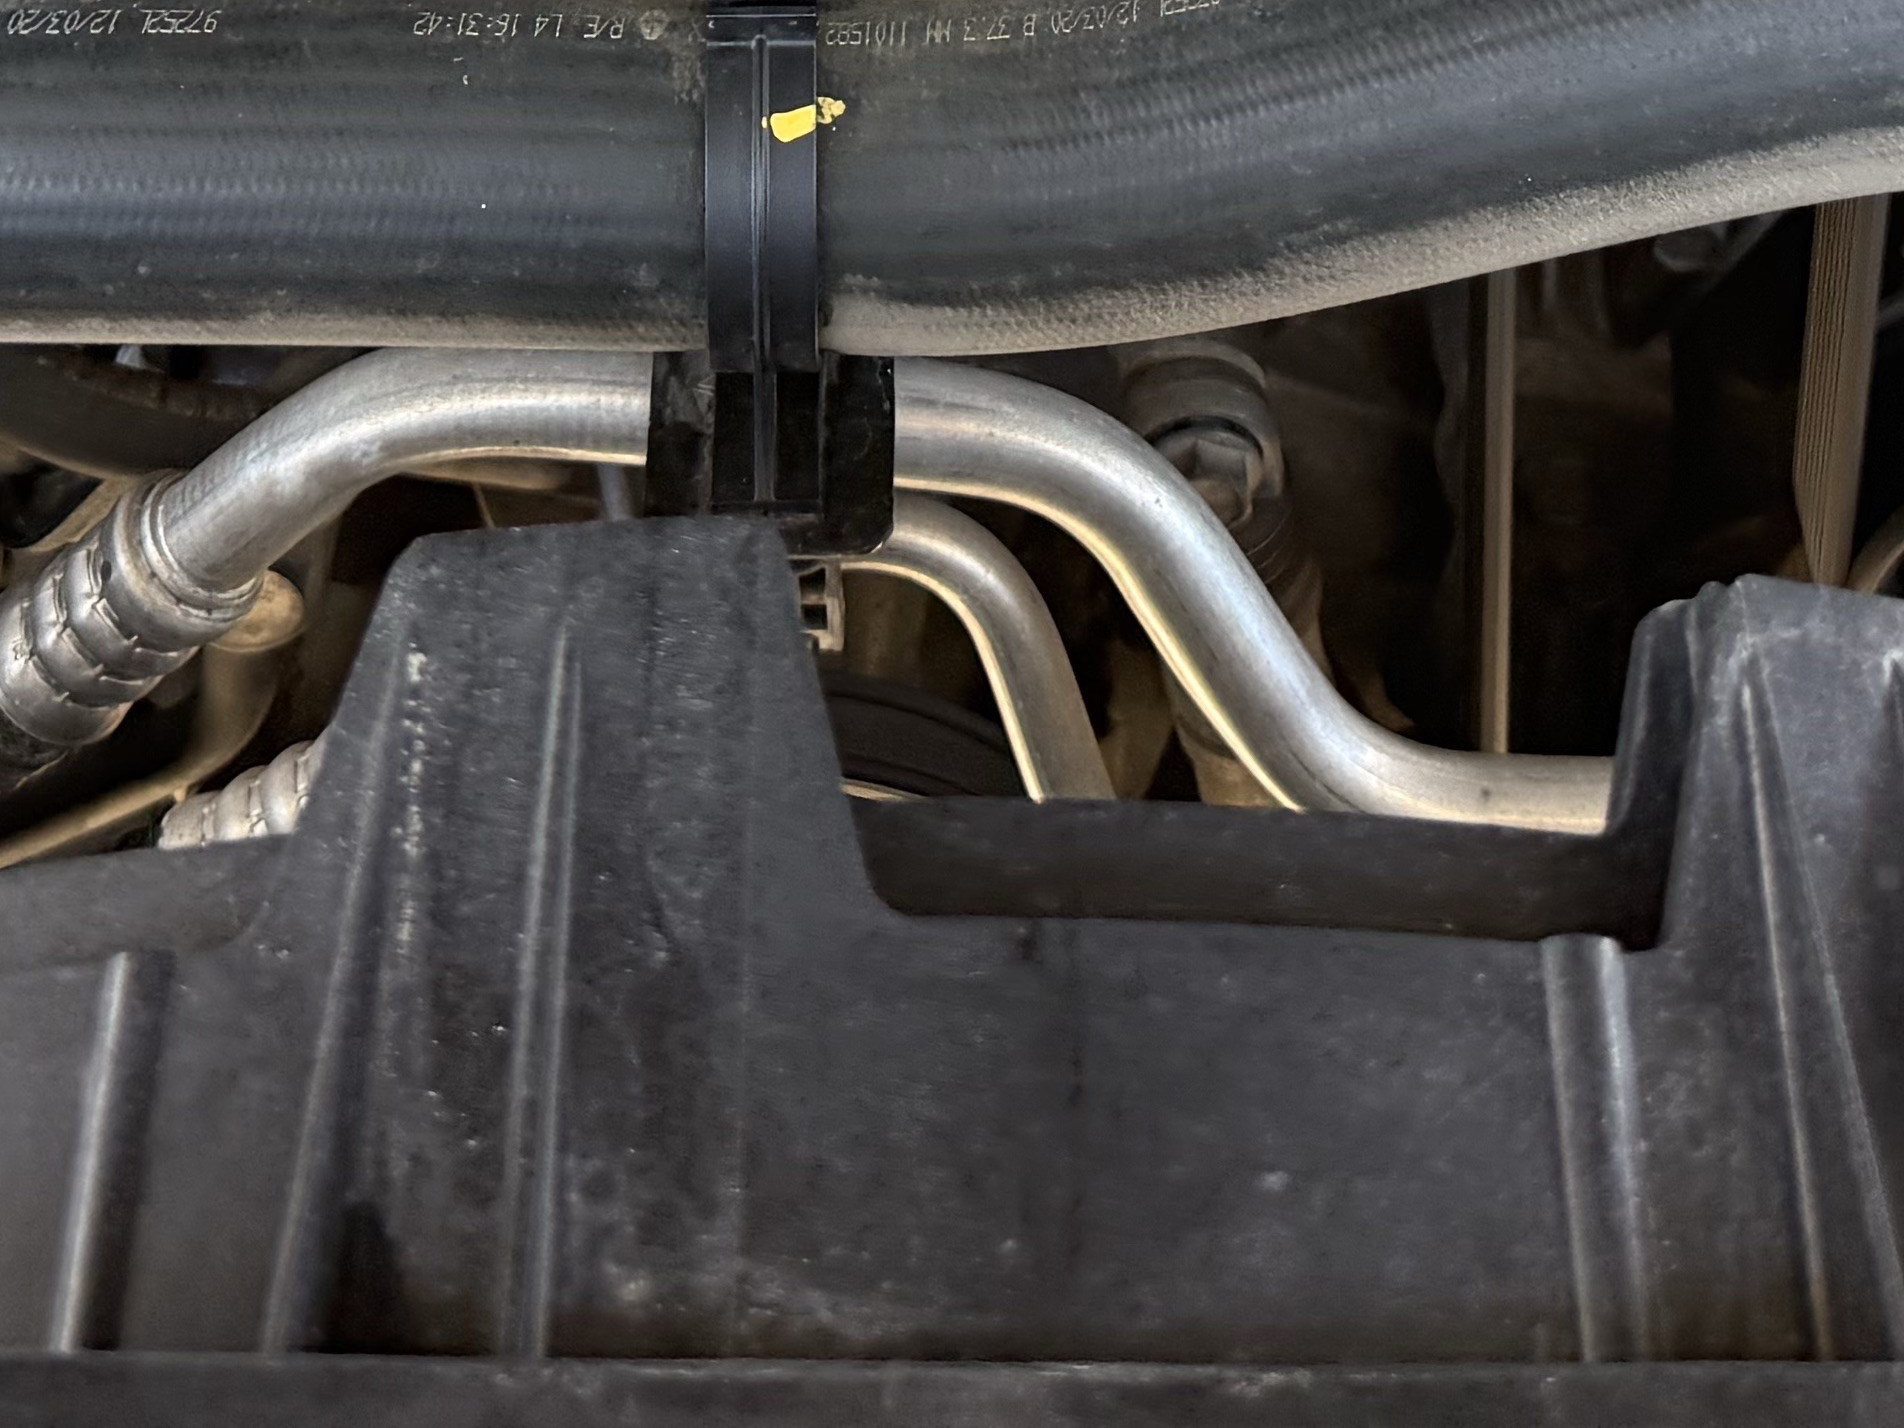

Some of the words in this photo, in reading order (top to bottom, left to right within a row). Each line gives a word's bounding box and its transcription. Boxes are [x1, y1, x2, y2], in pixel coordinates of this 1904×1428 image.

[7, 9, 121, 34] 12/03/20
[533, 14, 563, 37] L4
[583, 15, 625, 39] R/E
